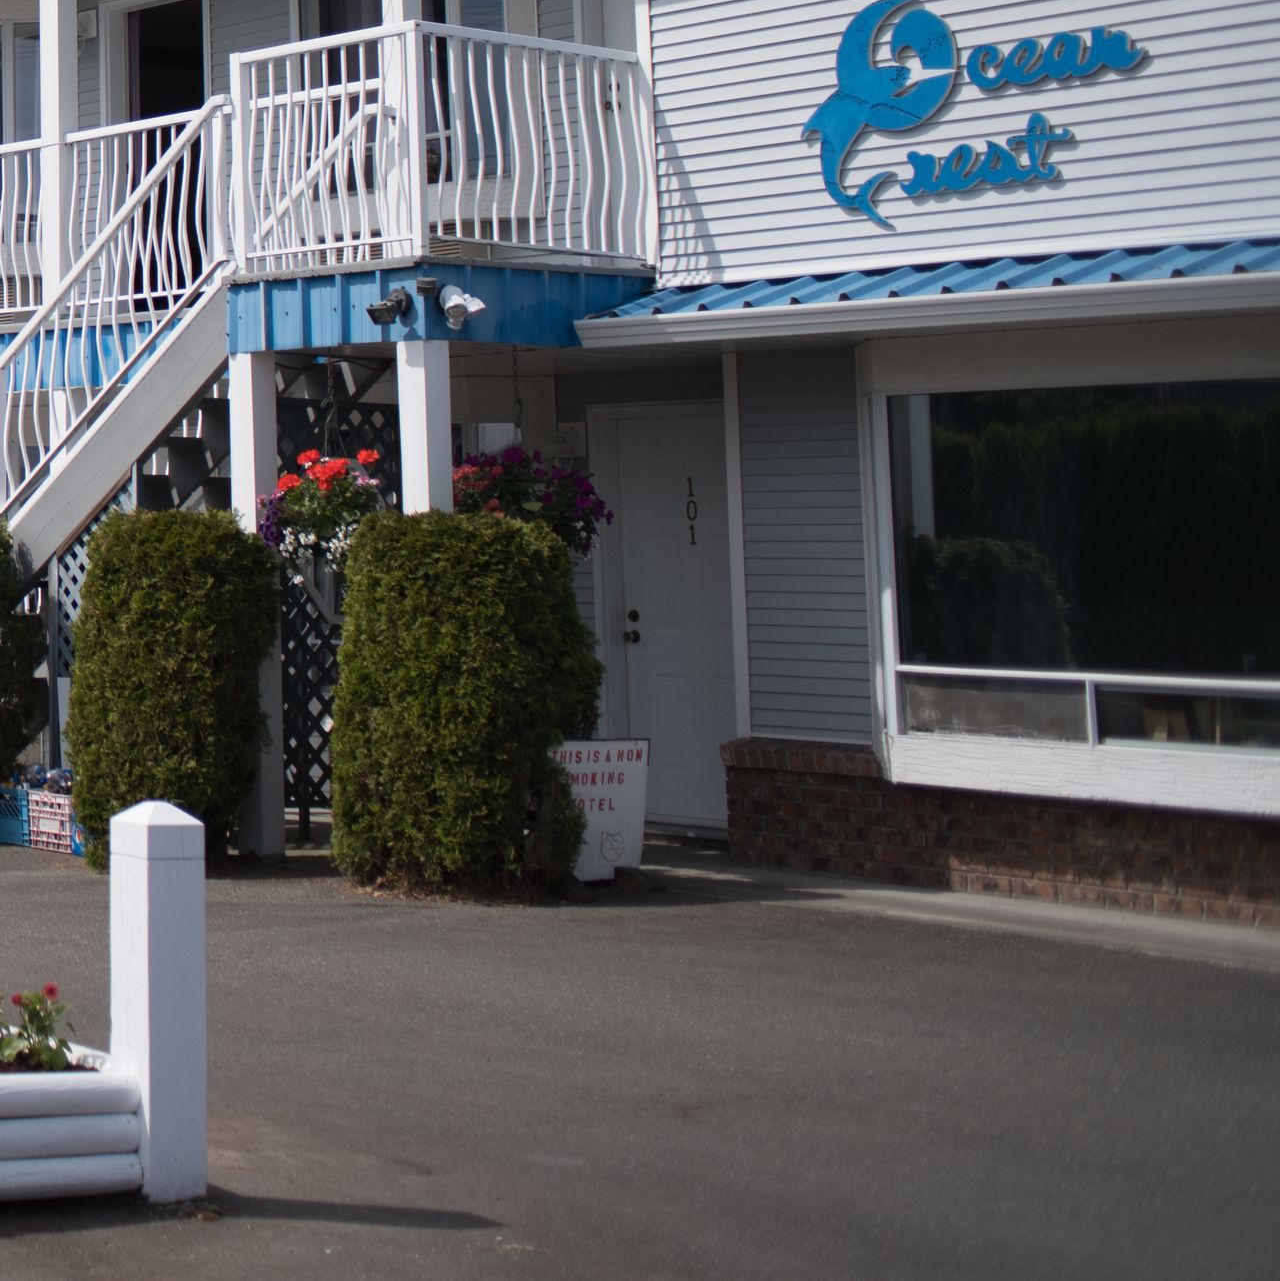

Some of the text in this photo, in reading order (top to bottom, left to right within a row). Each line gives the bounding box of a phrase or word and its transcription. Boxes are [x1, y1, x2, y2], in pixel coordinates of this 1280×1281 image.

[685, 475, 698, 546] 101
[551, 748, 643, 765] THIS IS A NON
[571, 771, 625, 786] MOKING
[573, 797, 616, 812] OTEL
